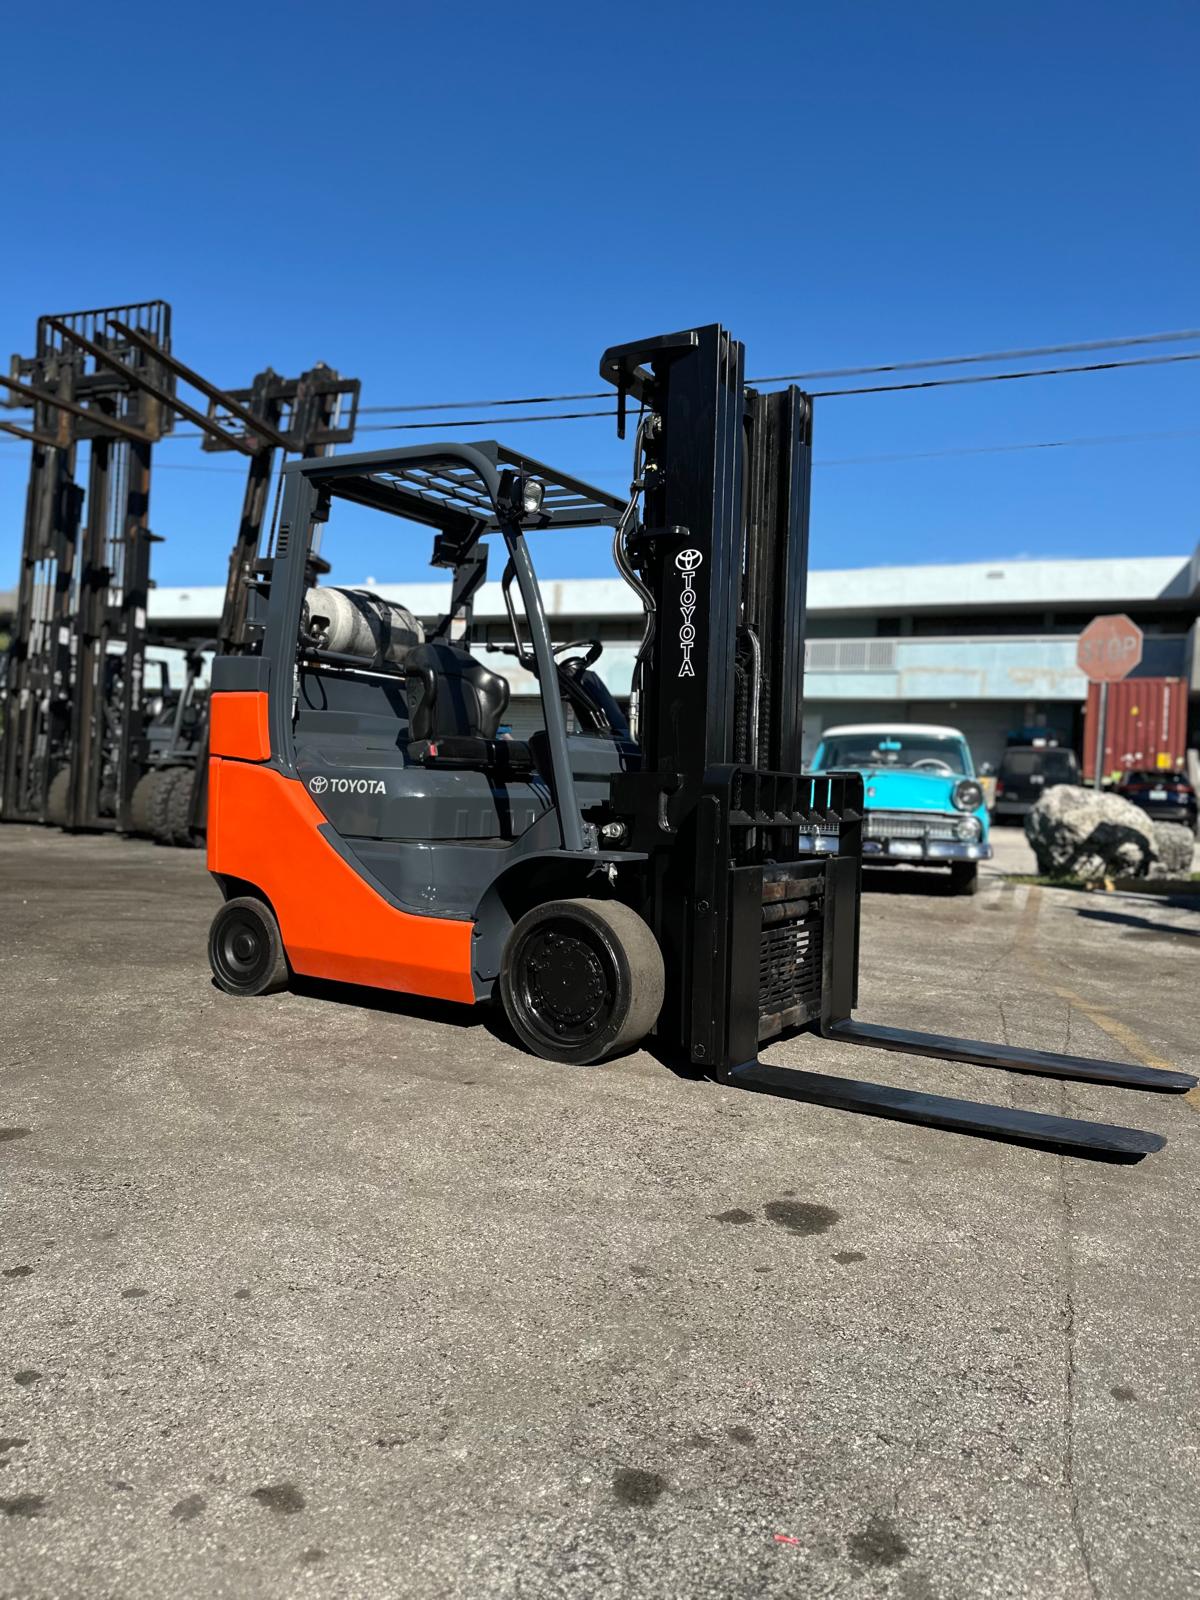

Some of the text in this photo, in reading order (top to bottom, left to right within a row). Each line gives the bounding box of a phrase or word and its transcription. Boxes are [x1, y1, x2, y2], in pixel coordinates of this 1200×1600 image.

[678, 571, 697, 677] TOYOTA
[1080, 636, 1137, 663] STOP
[330, 779, 387, 795] TOYOTA
